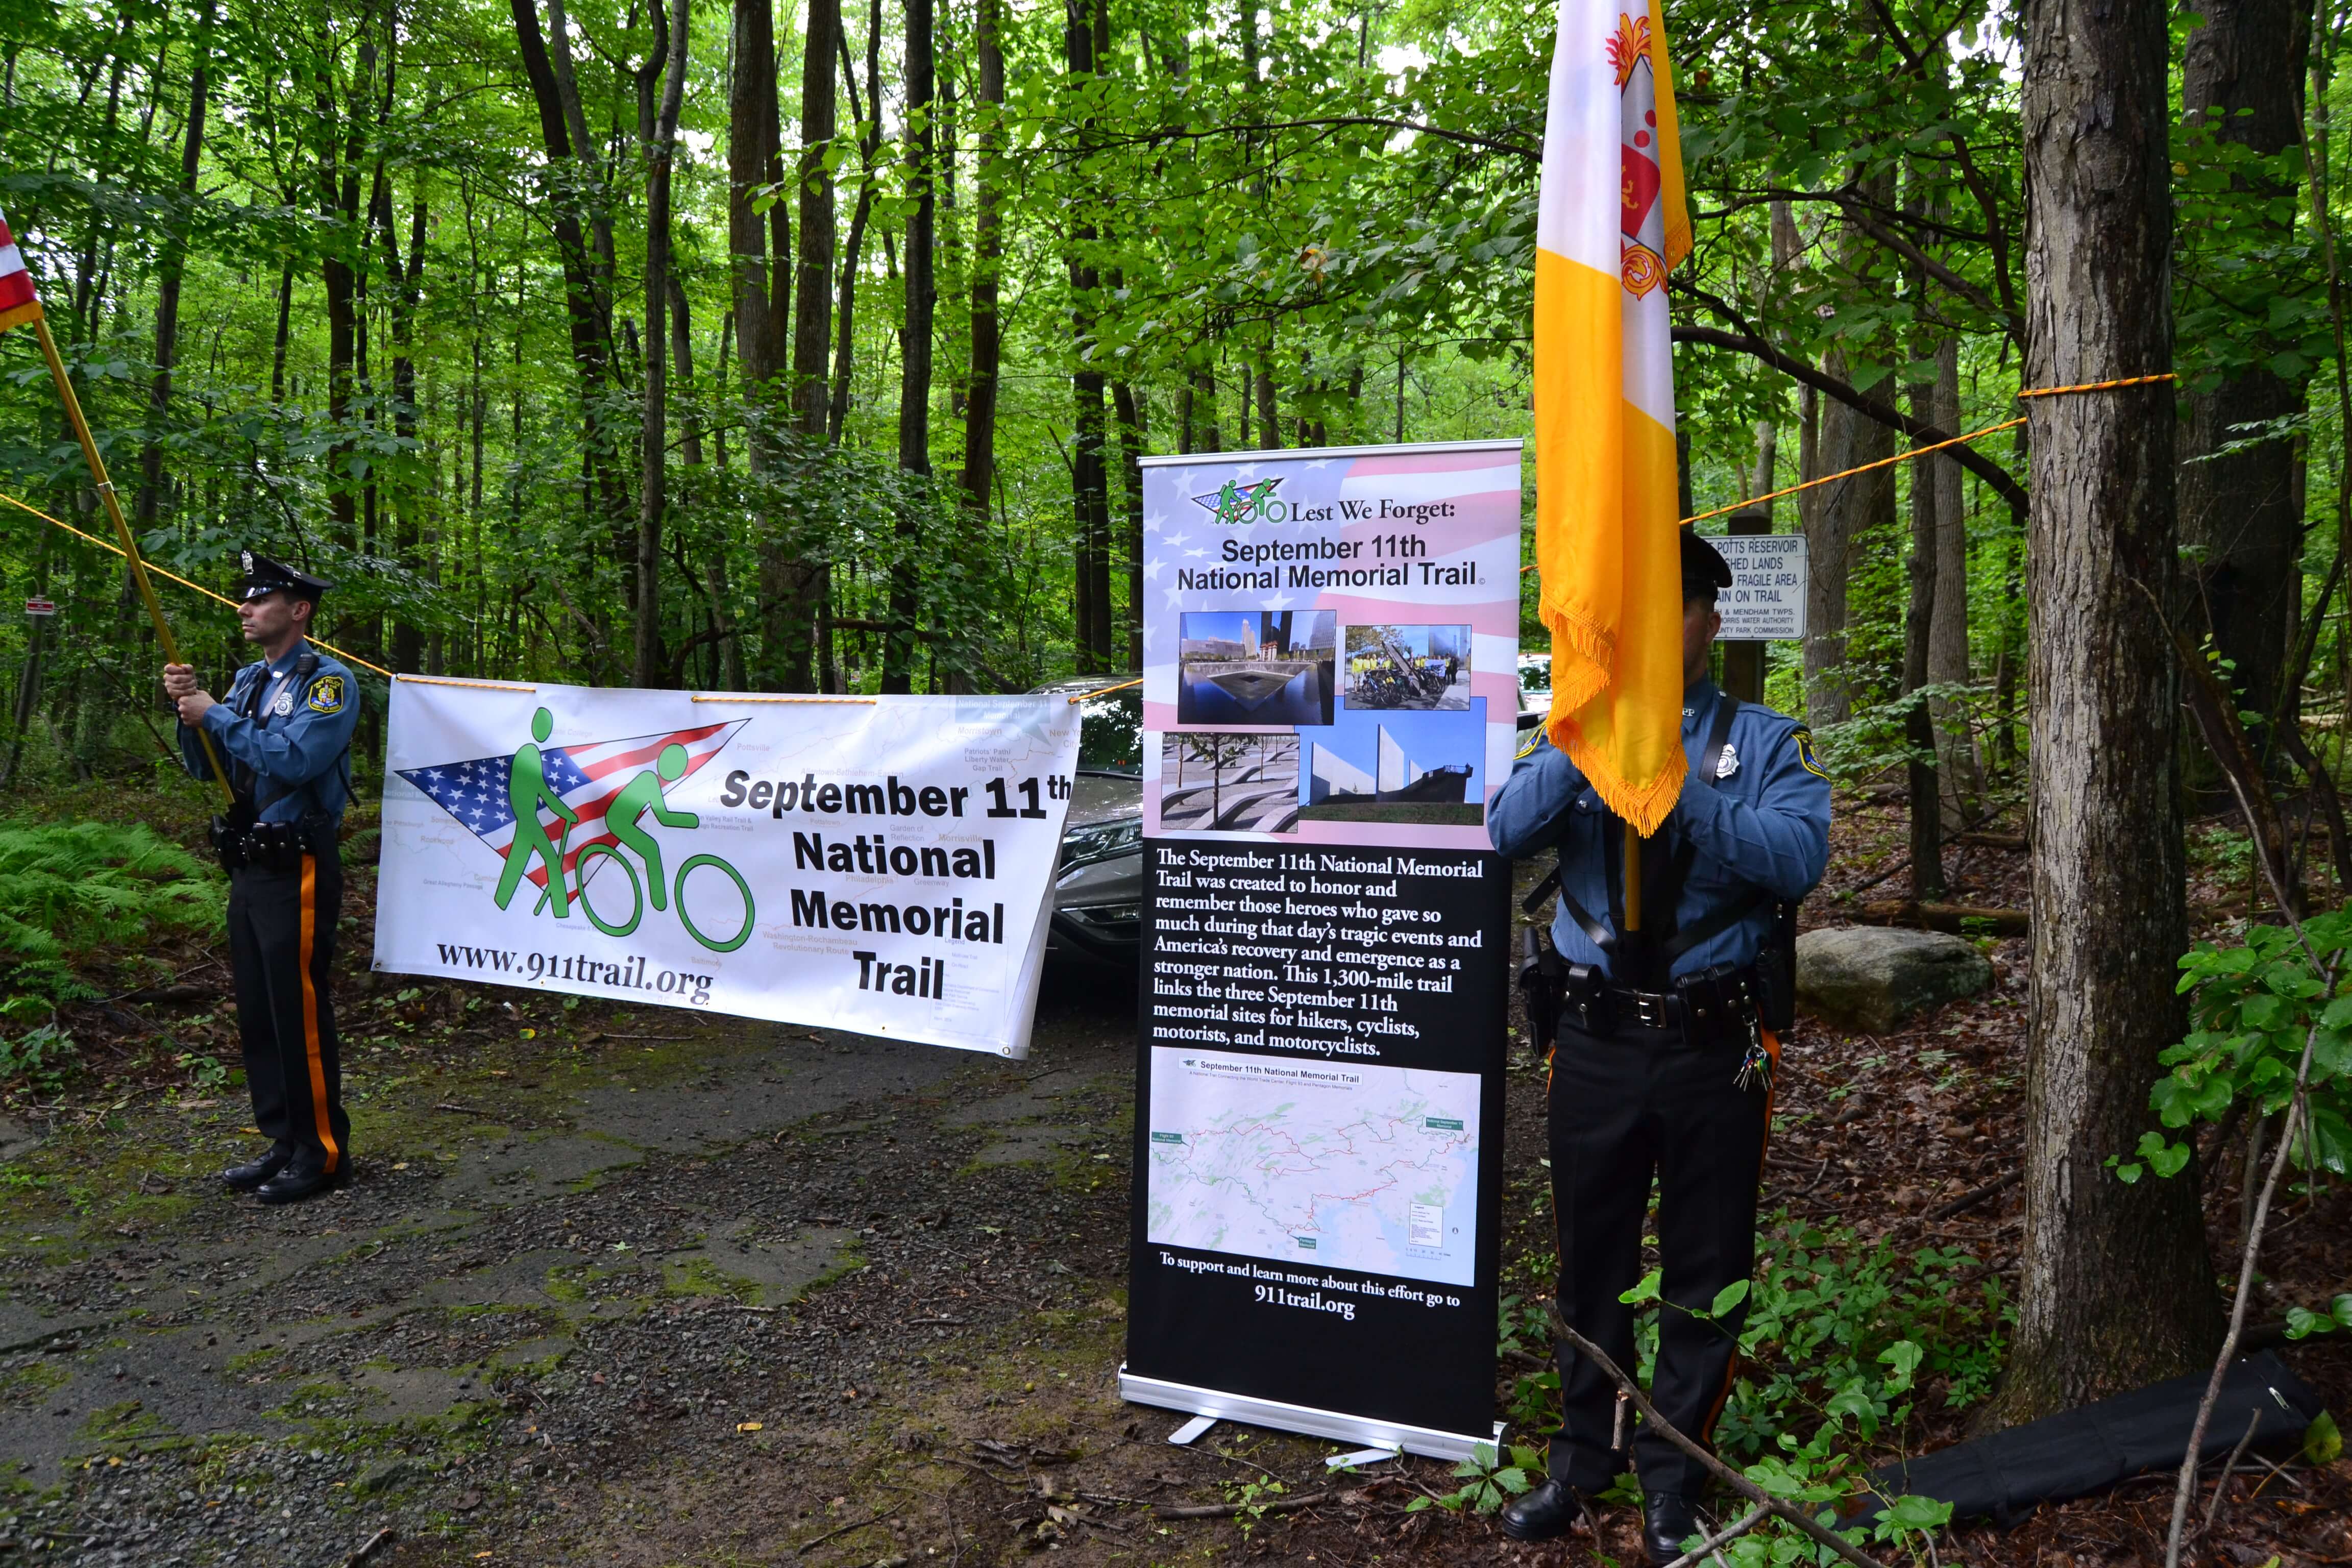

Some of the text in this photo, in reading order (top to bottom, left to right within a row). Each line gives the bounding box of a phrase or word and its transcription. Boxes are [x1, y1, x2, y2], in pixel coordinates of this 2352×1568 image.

[1291, 499, 1455, 525] Lest We Forget:
[1221, 534, 1426, 567] September 11th
[1718, 541, 1745, 553] POTTS
[1749, 540, 1798, 553] RESERVOIR
[1178, 561, 1476, 590] National Memorial Trail
[1752, 557, 1783, 570] LANDS
[1737, 574, 1771, 586] FRAGILE
[1775, 574, 1797, 585] AREA
[1735, 590, 1750, 602] ON
[1755, 590, 1782, 602] TRAIL
[959, 699, 989, 707] National
[992, 699, 1036, 708] September
[958, 727, 1002, 736] Morristown
[1049, 729, 1069, 737] New
[737, 743, 770, 752] Pottsville
[721, 770, 1071, 819] September 11th
[939, 834, 983, 842] Morrisville
[793, 831, 995, 879] National
[1157, 848, 1483, 878] The September 11th National Memorial
[845, 875, 894, 885] Philadelphia
[914, 878, 949, 887] Greenway
[1156, 869, 1398, 897] Trail was created to honor and
[790, 889, 1003, 944] Memorial
[1156, 893, 1441, 925] remember those heroes who gave so
[763, 930, 857, 945] Washington-Rochambeau
[1155, 914, 1483, 948] much during that day's tragic events and
[773, 942, 849, 955] Revolutionary Route
[1154, 935, 1461, 971] America's recovery and emergence as a
[436, 943, 714, 1006] www.911trail.org
[852, 950, 944, 1000] Trail
[1154, 961, 1453, 993] stronger nation. This 1,300-mile trail
[1154, 977, 1398, 1012] links the three September 11th
[1153, 1003, 1419, 1039] memorial sites for hikers, cyclists,
[1153, 1025, 1380, 1057] motorists, and motorcyclists.
[1200, 1061, 1359, 1083] September 11th National Memorial Trail
[1160, 1251, 1460, 1307] To support and learn more about this effort go to
[1255, 1285, 1355, 1320] 911trail.org
